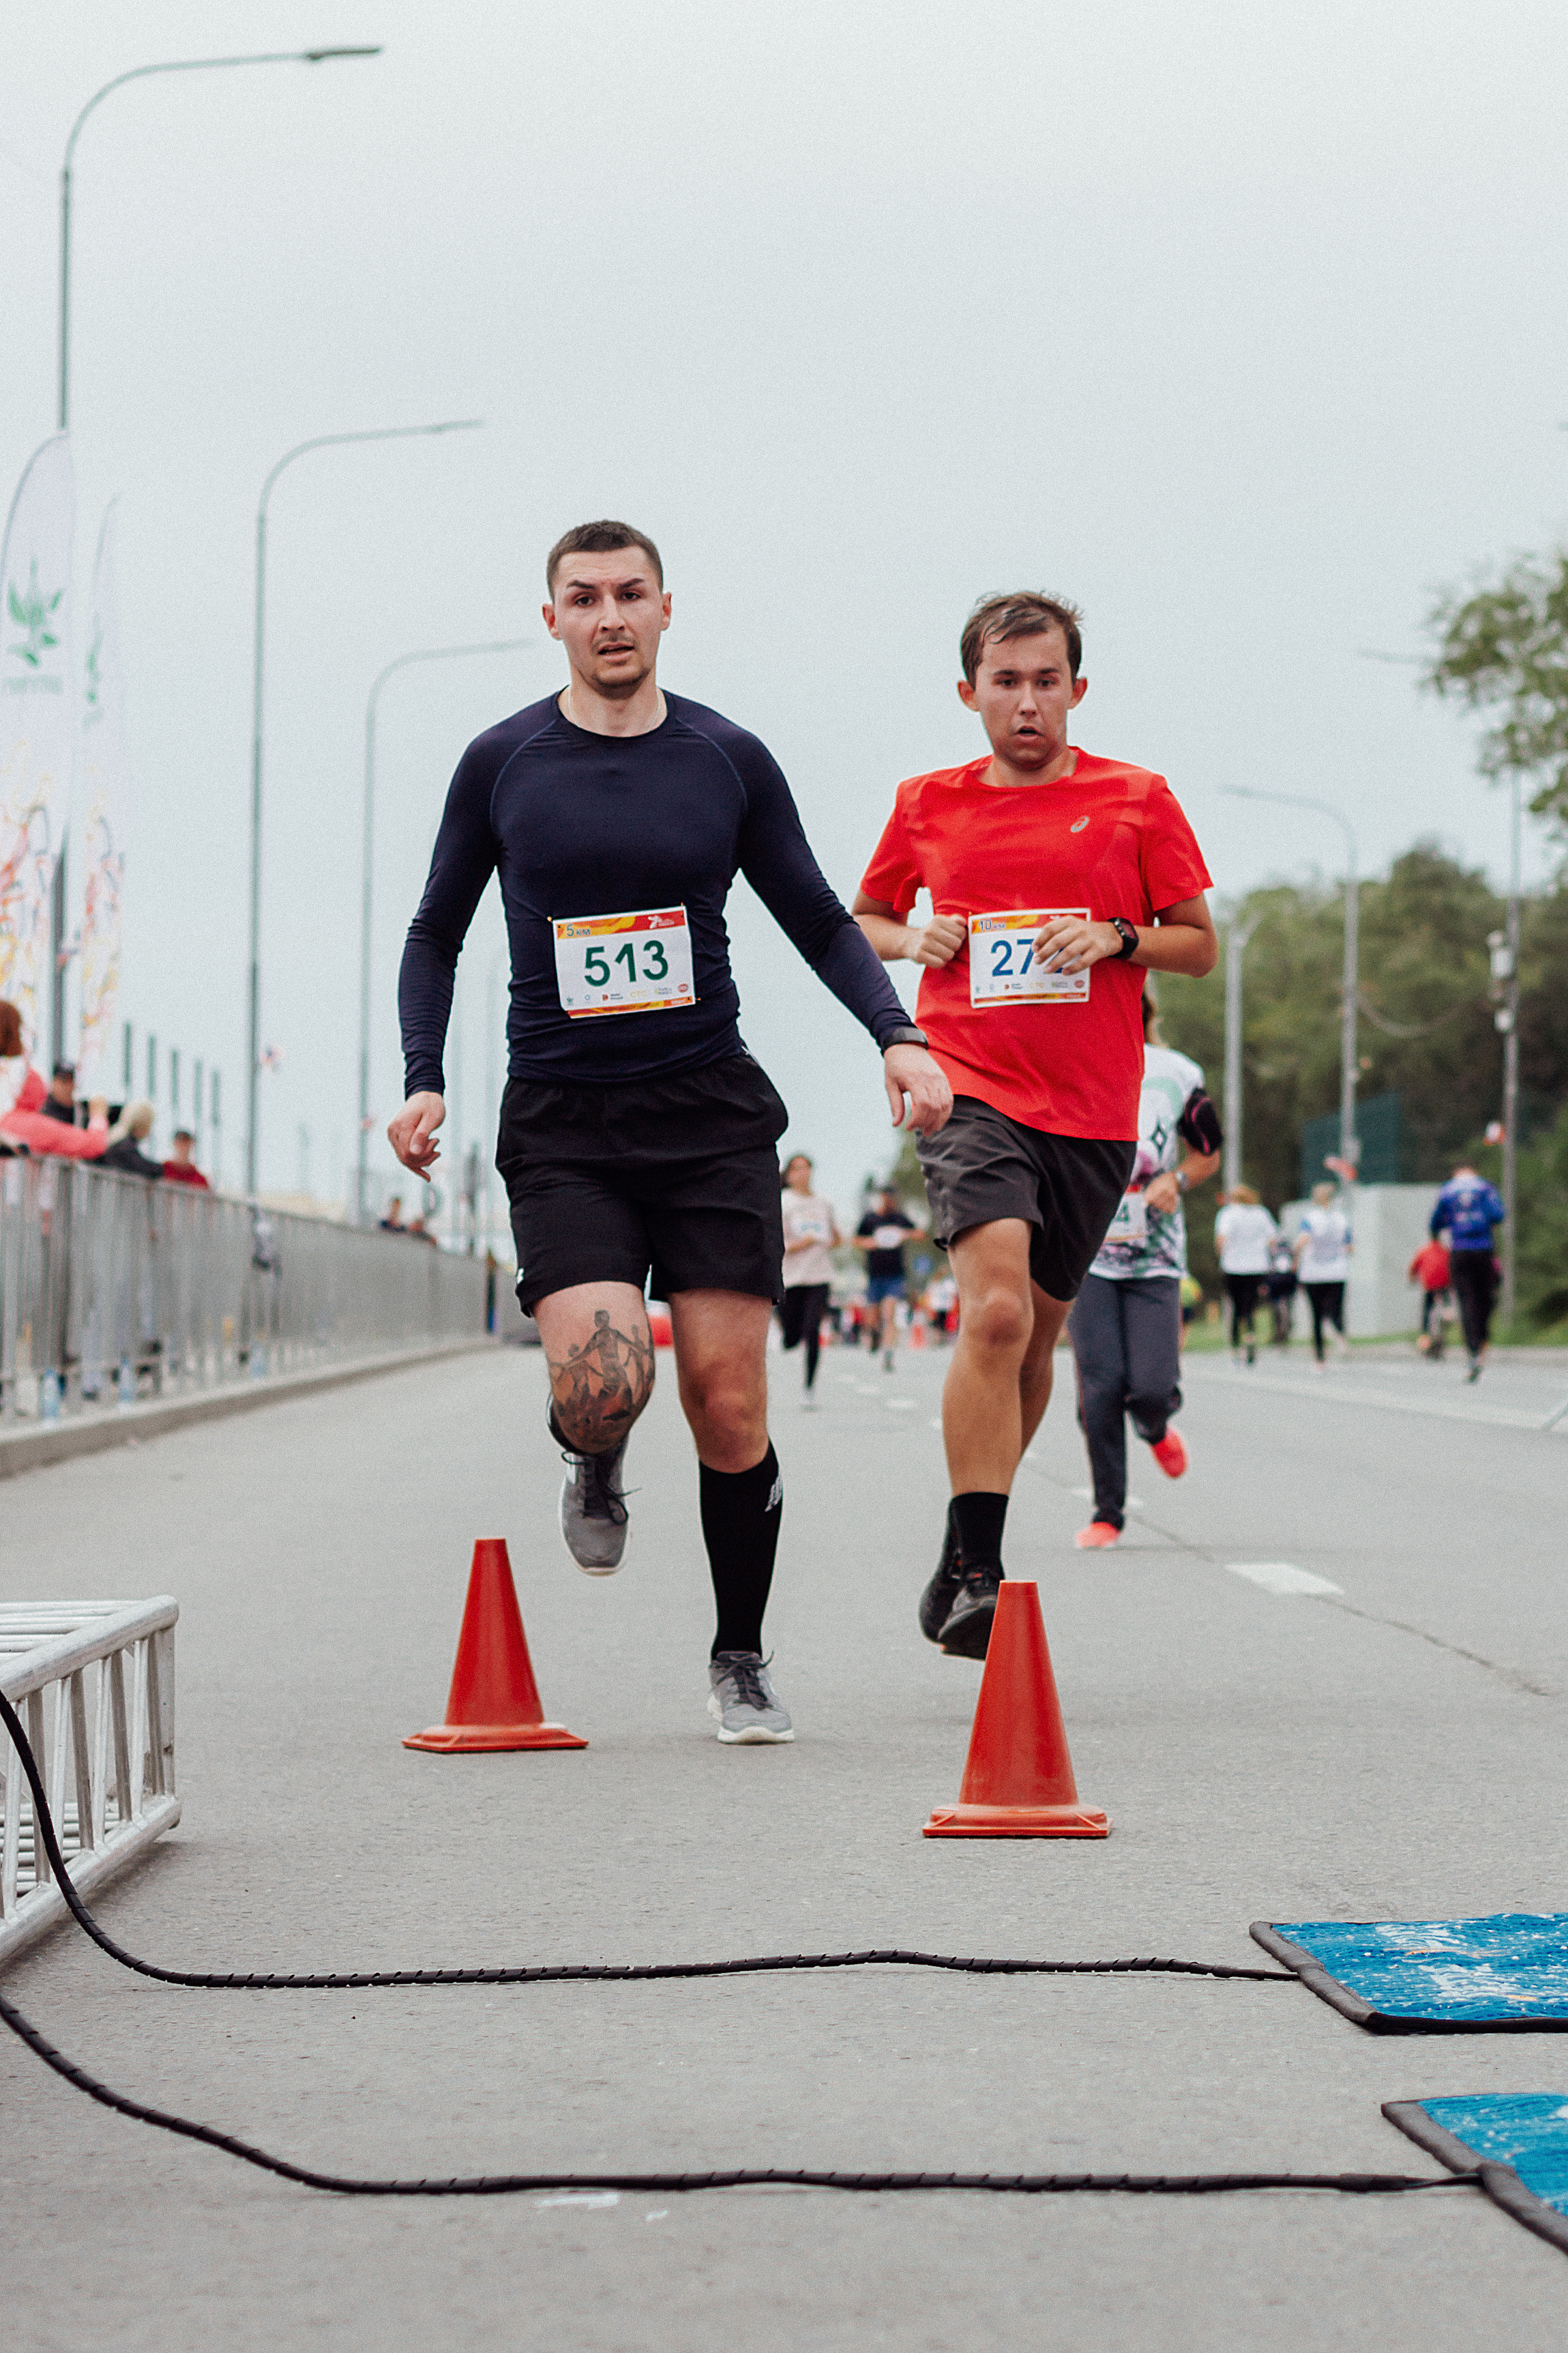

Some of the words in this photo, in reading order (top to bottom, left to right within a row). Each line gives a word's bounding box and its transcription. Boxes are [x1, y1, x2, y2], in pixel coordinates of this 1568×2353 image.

[566, 924, 574, 937] 5
[979, 919, 992, 931] 10
[585, 940, 668, 986] 513
